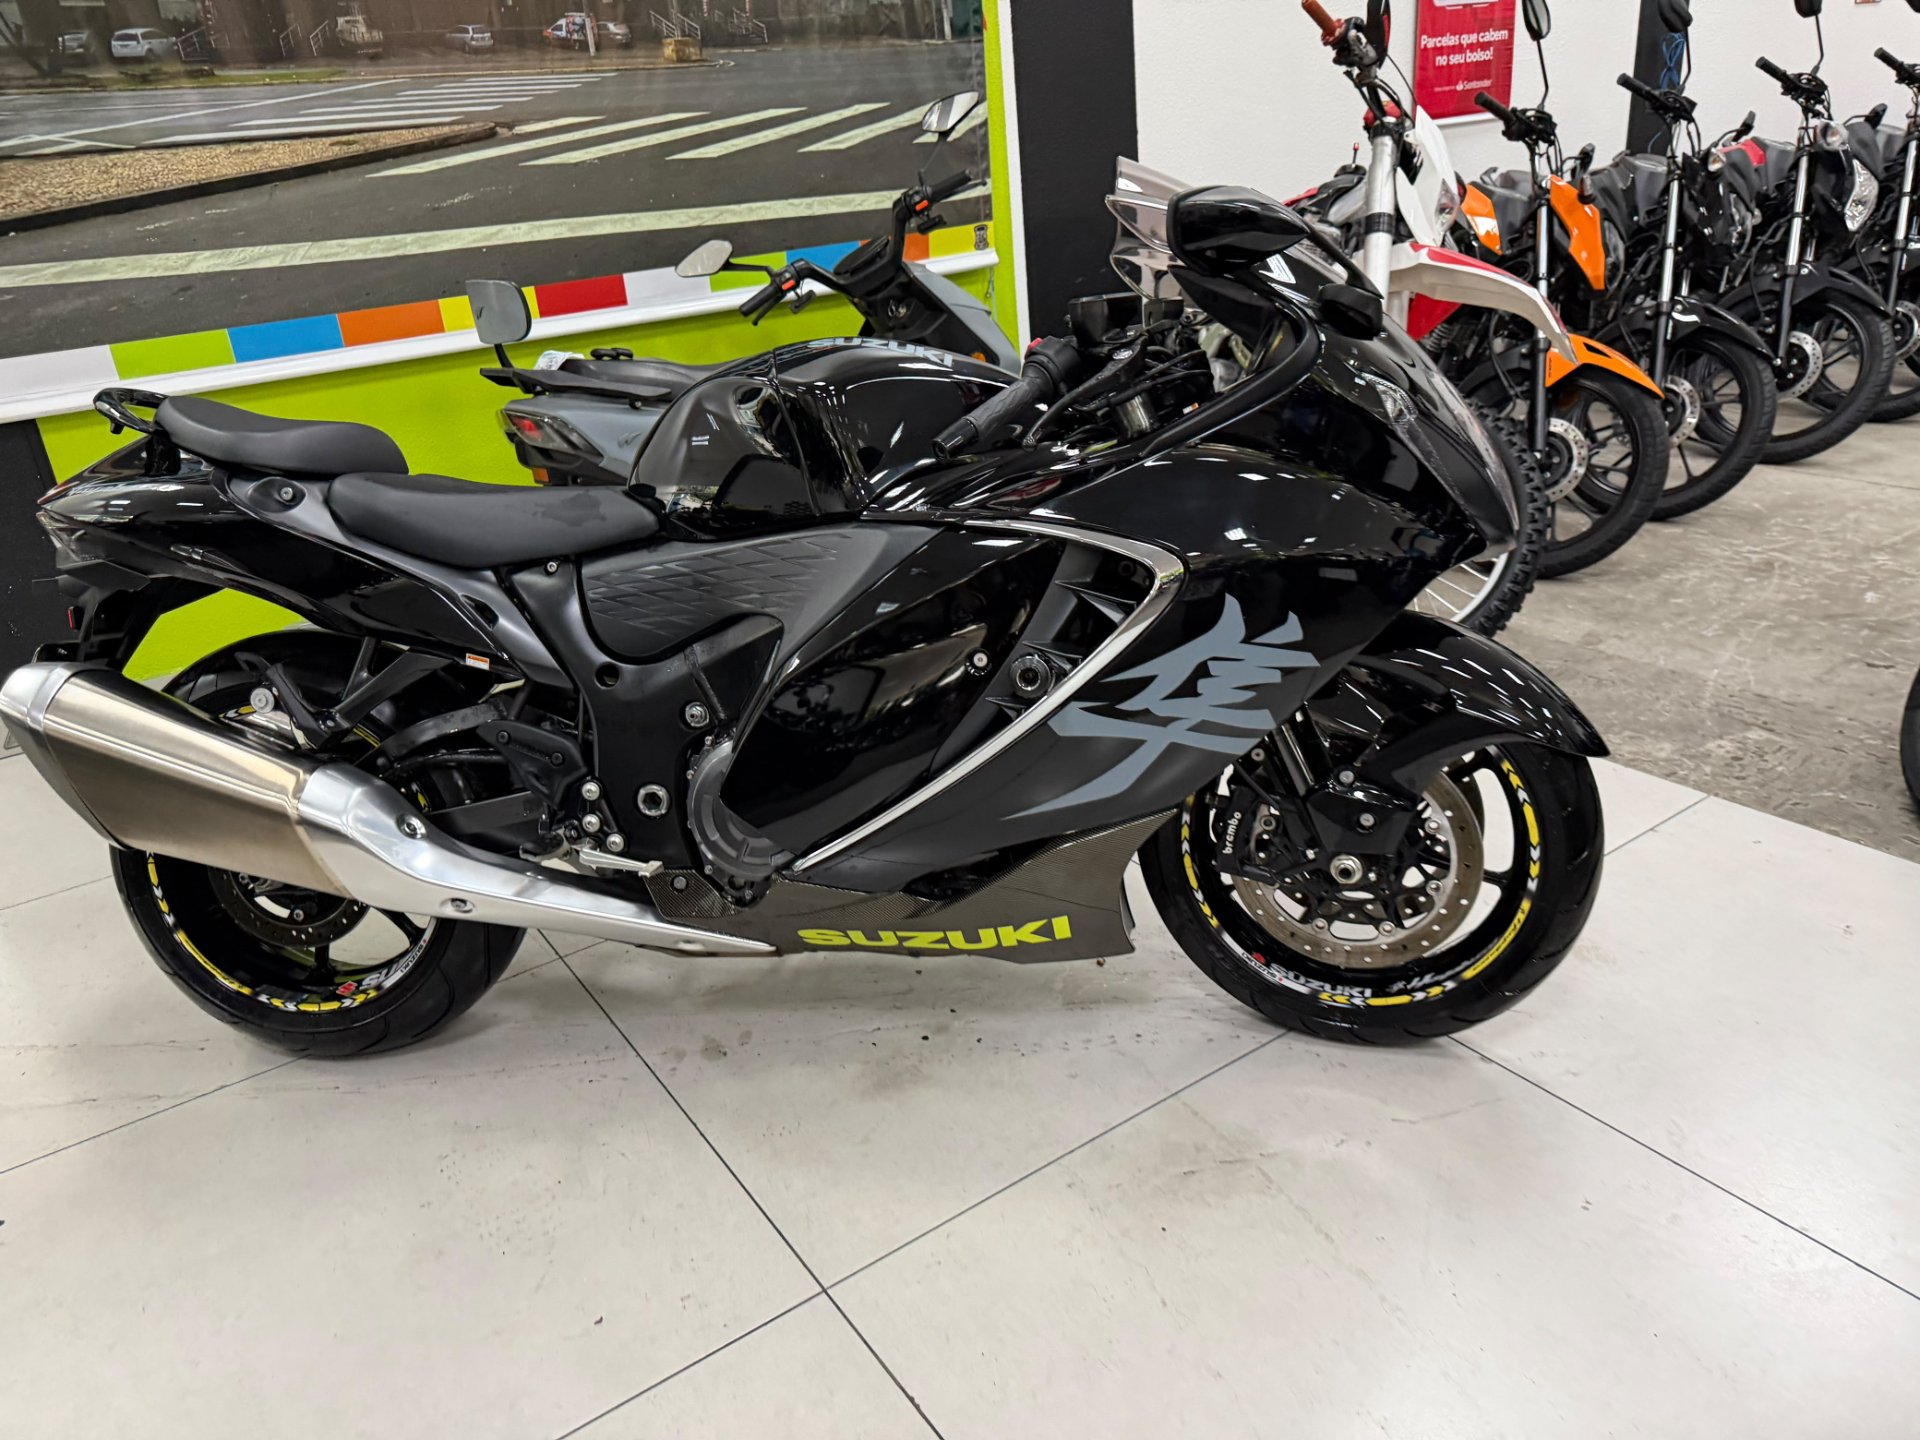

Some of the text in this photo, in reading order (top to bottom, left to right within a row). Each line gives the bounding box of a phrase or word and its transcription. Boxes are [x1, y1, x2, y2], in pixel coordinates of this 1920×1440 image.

[1420, 28, 1509, 49] Parcelas que cabem
[1435, 47, 1494, 66] no seu bolso!
[1463, 79, 1493, 90] Santander
[807, 337, 953, 367] SUZUKI
[1222, 811, 1242, 854] brembo
[797, 915, 1072, 950] SUZUKI
[400, 944, 424, 974] SUZUKI
[1269, 962, 1373, 998] SUZUKI
